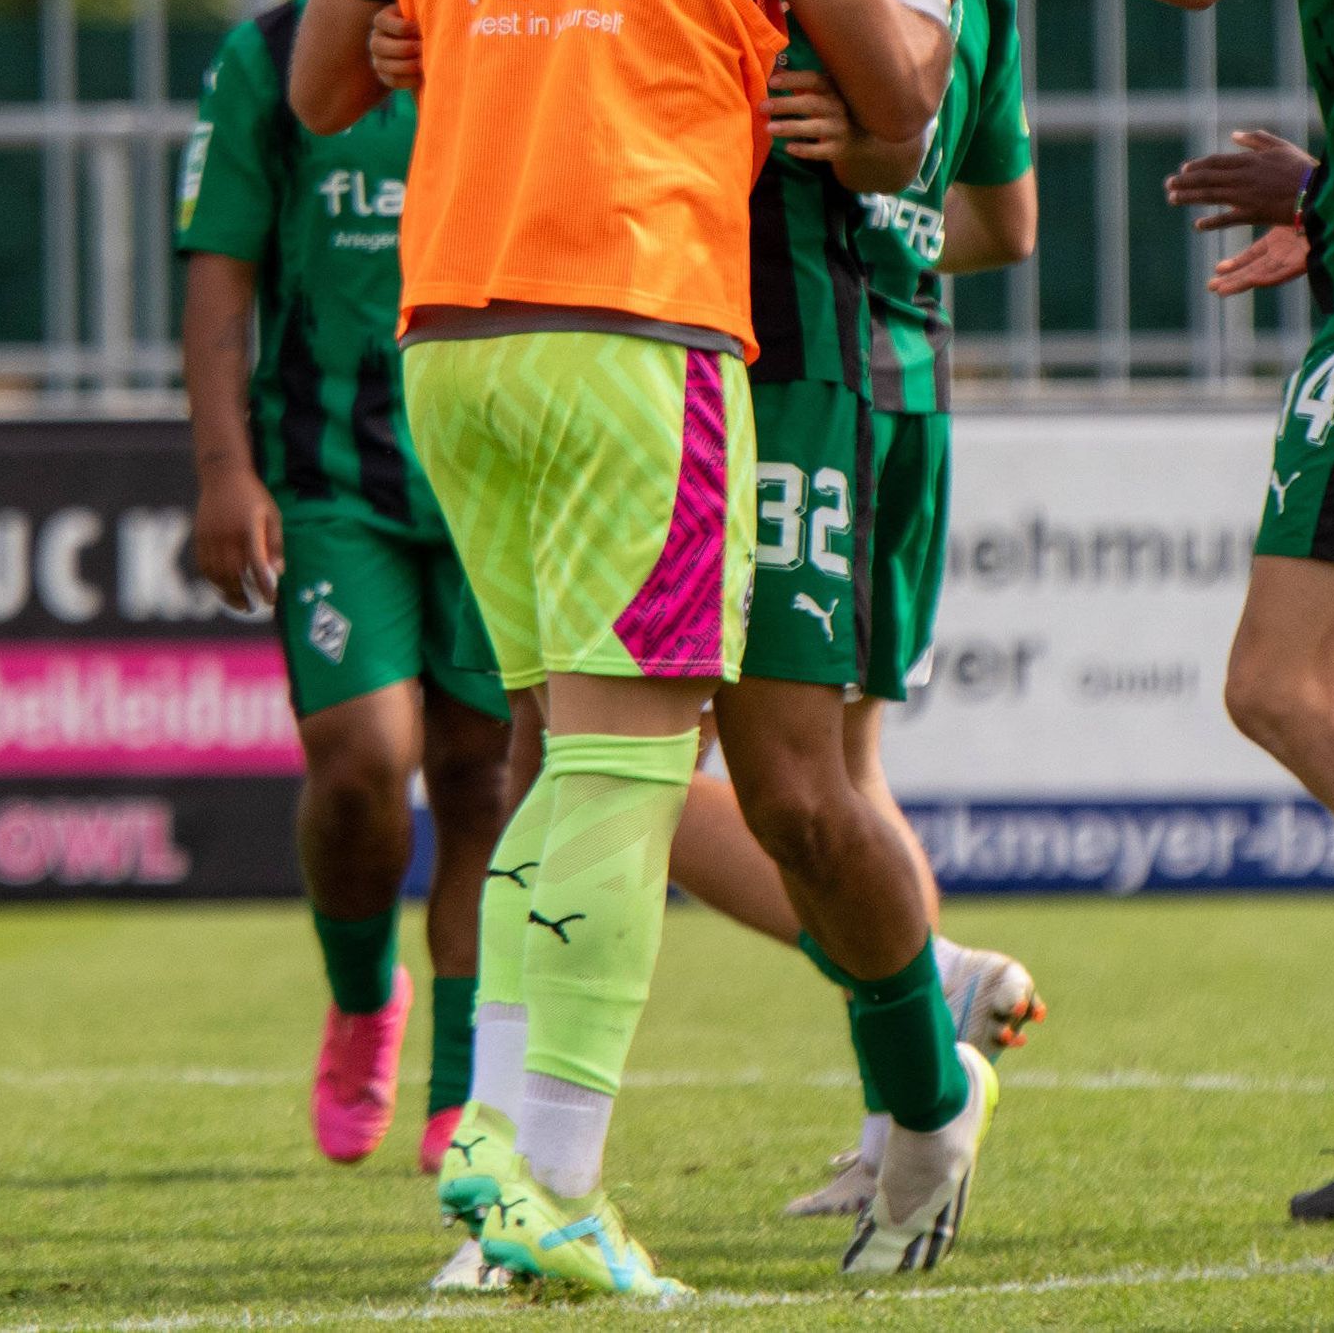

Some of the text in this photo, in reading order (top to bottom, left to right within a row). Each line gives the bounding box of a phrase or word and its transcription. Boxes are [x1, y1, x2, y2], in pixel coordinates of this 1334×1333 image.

[526, 10, 550, 35] in
[319, 168, 407, 217] fla
[756, 461, 853, 581] 32
